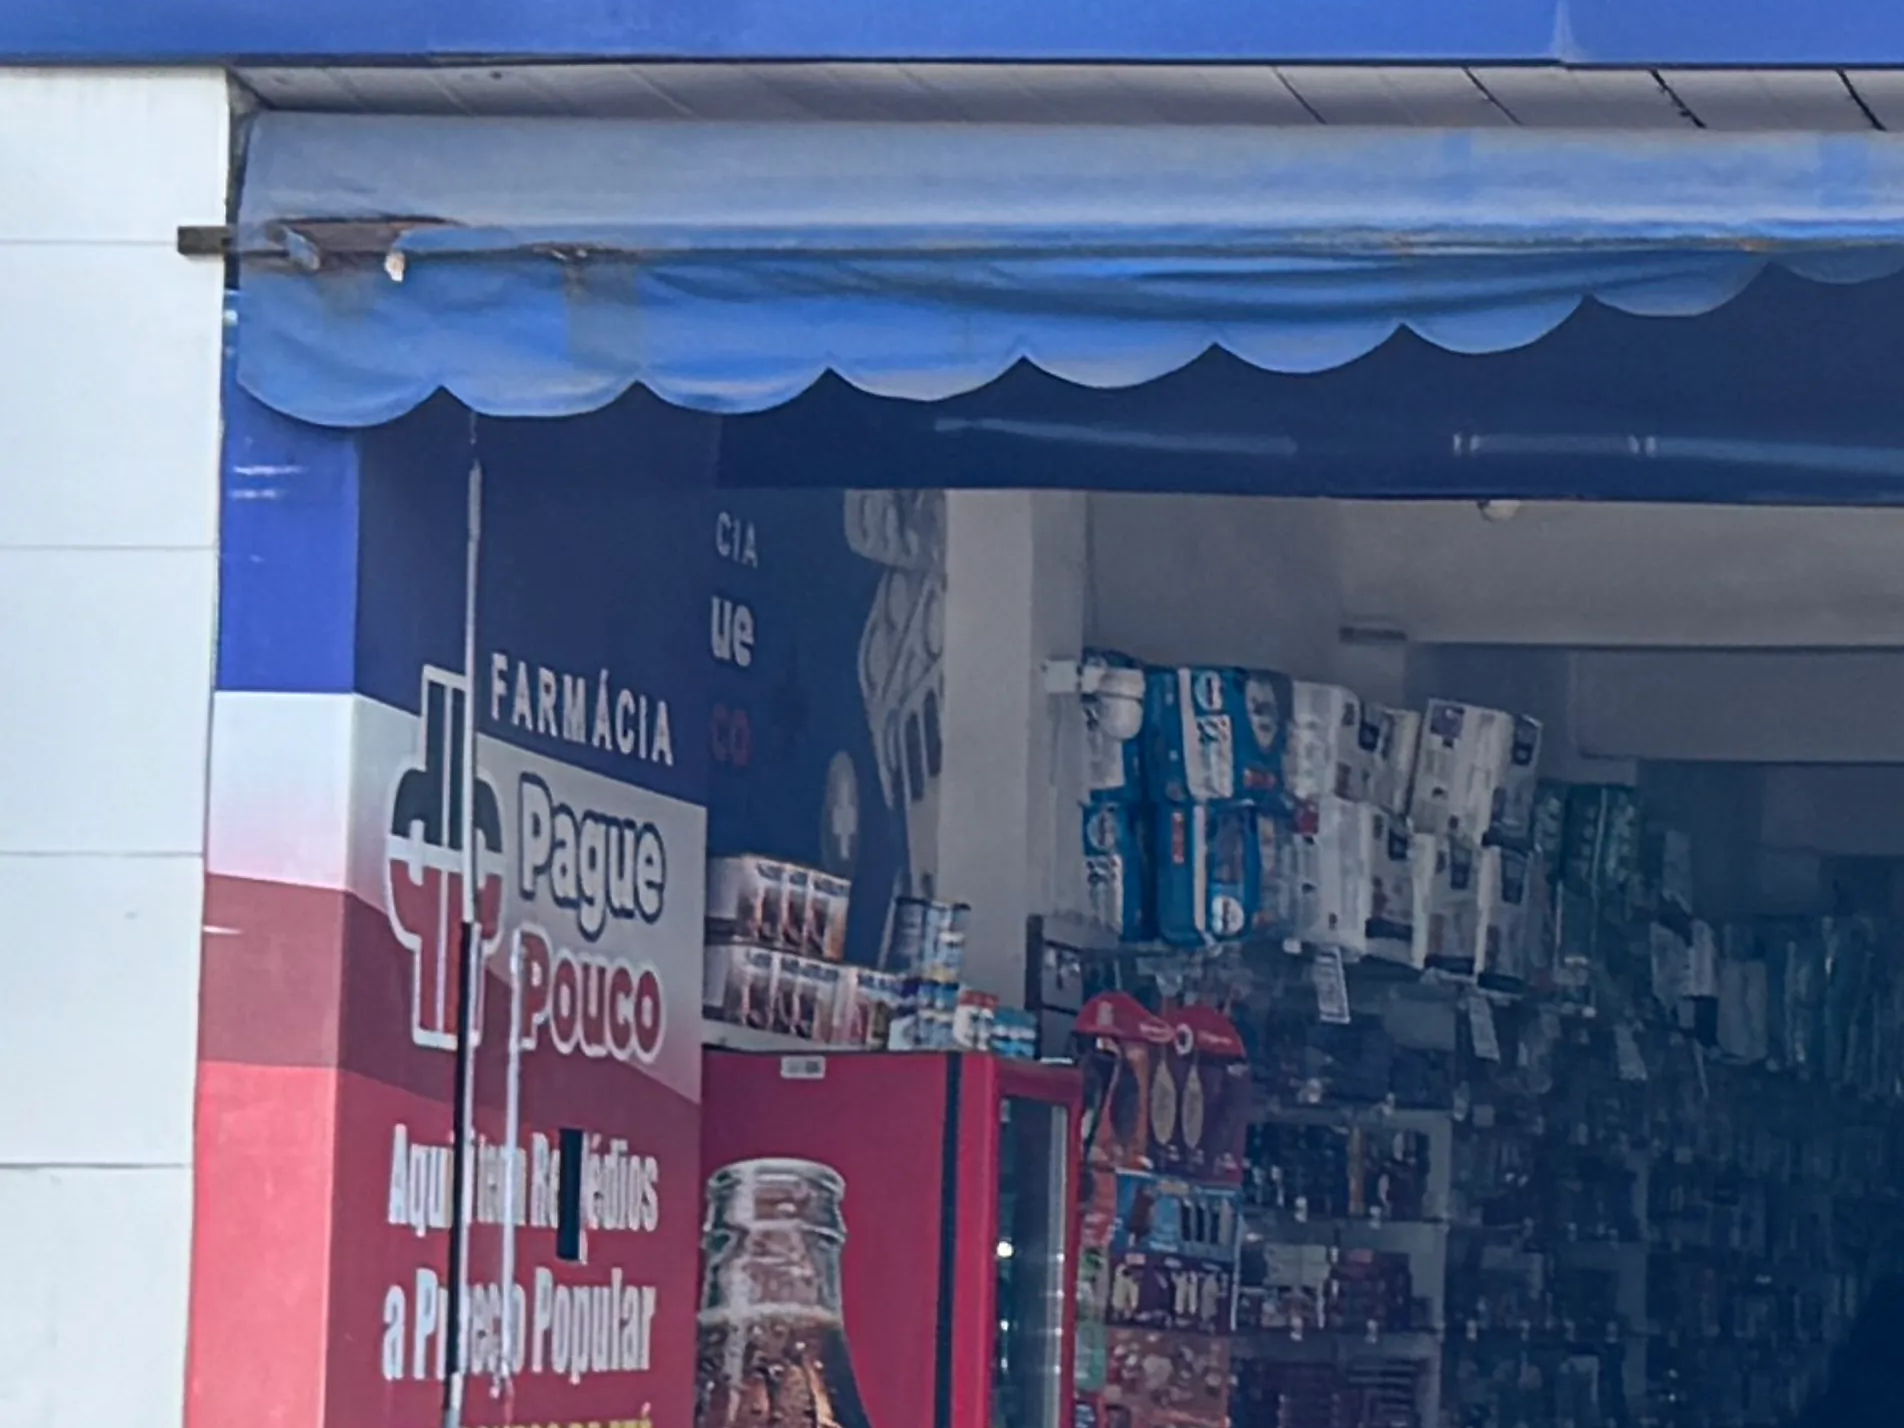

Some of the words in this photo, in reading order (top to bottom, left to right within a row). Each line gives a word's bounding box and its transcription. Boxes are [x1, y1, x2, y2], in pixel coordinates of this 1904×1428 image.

[490, 651, 674, 767] FARMÁCIA
[518, 772, 666, 942] Pague
[516, 923, 664, 1064] Pouco
[531, 1130, 659, 1233] Reédios
[383, 1285, 406, 1381] a
[531, 1266, 656, 1385] Popular
